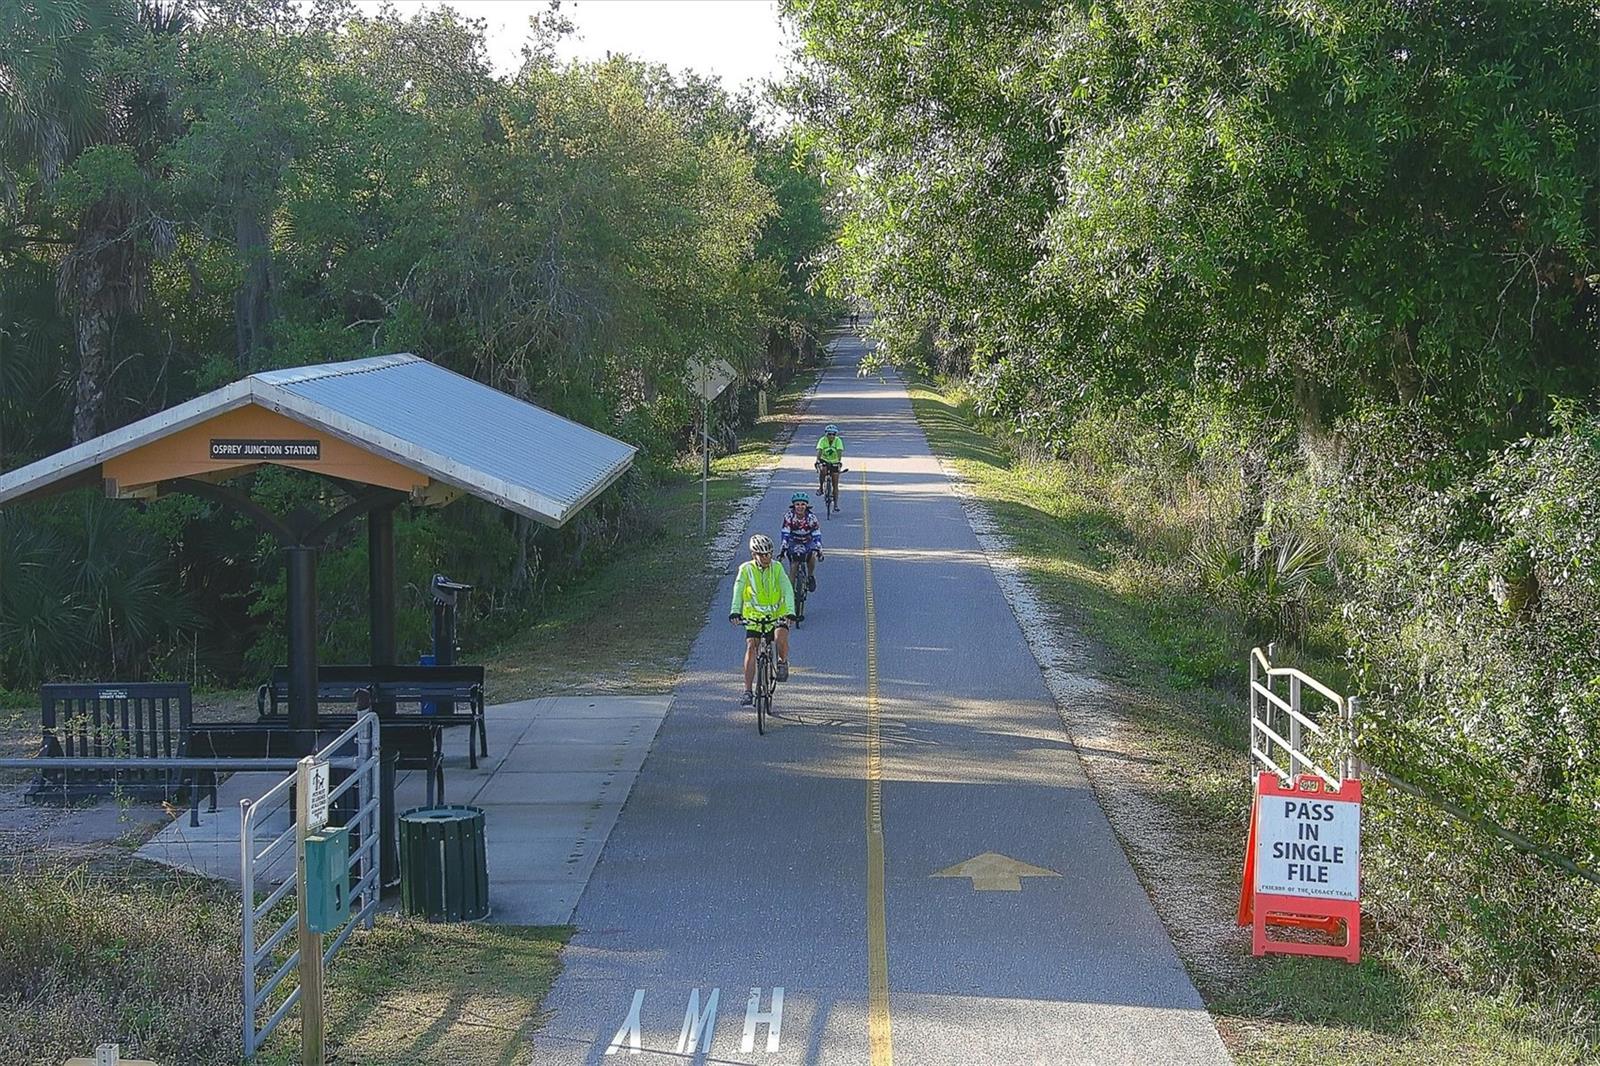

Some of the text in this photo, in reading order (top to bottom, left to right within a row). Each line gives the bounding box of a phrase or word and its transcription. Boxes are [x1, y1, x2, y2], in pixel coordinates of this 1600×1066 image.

[213, 445, 317, 455] OSPREY JUNCTION STATION
[1285, 801, 1334, 822] PASS
[1298, 823, 1319, 841] IN
[1273, 842, 1344, 864] SINGLE
[1288, 863, 1328, 883] FILE
[1310, 888, 1334, 896] LEGACY
